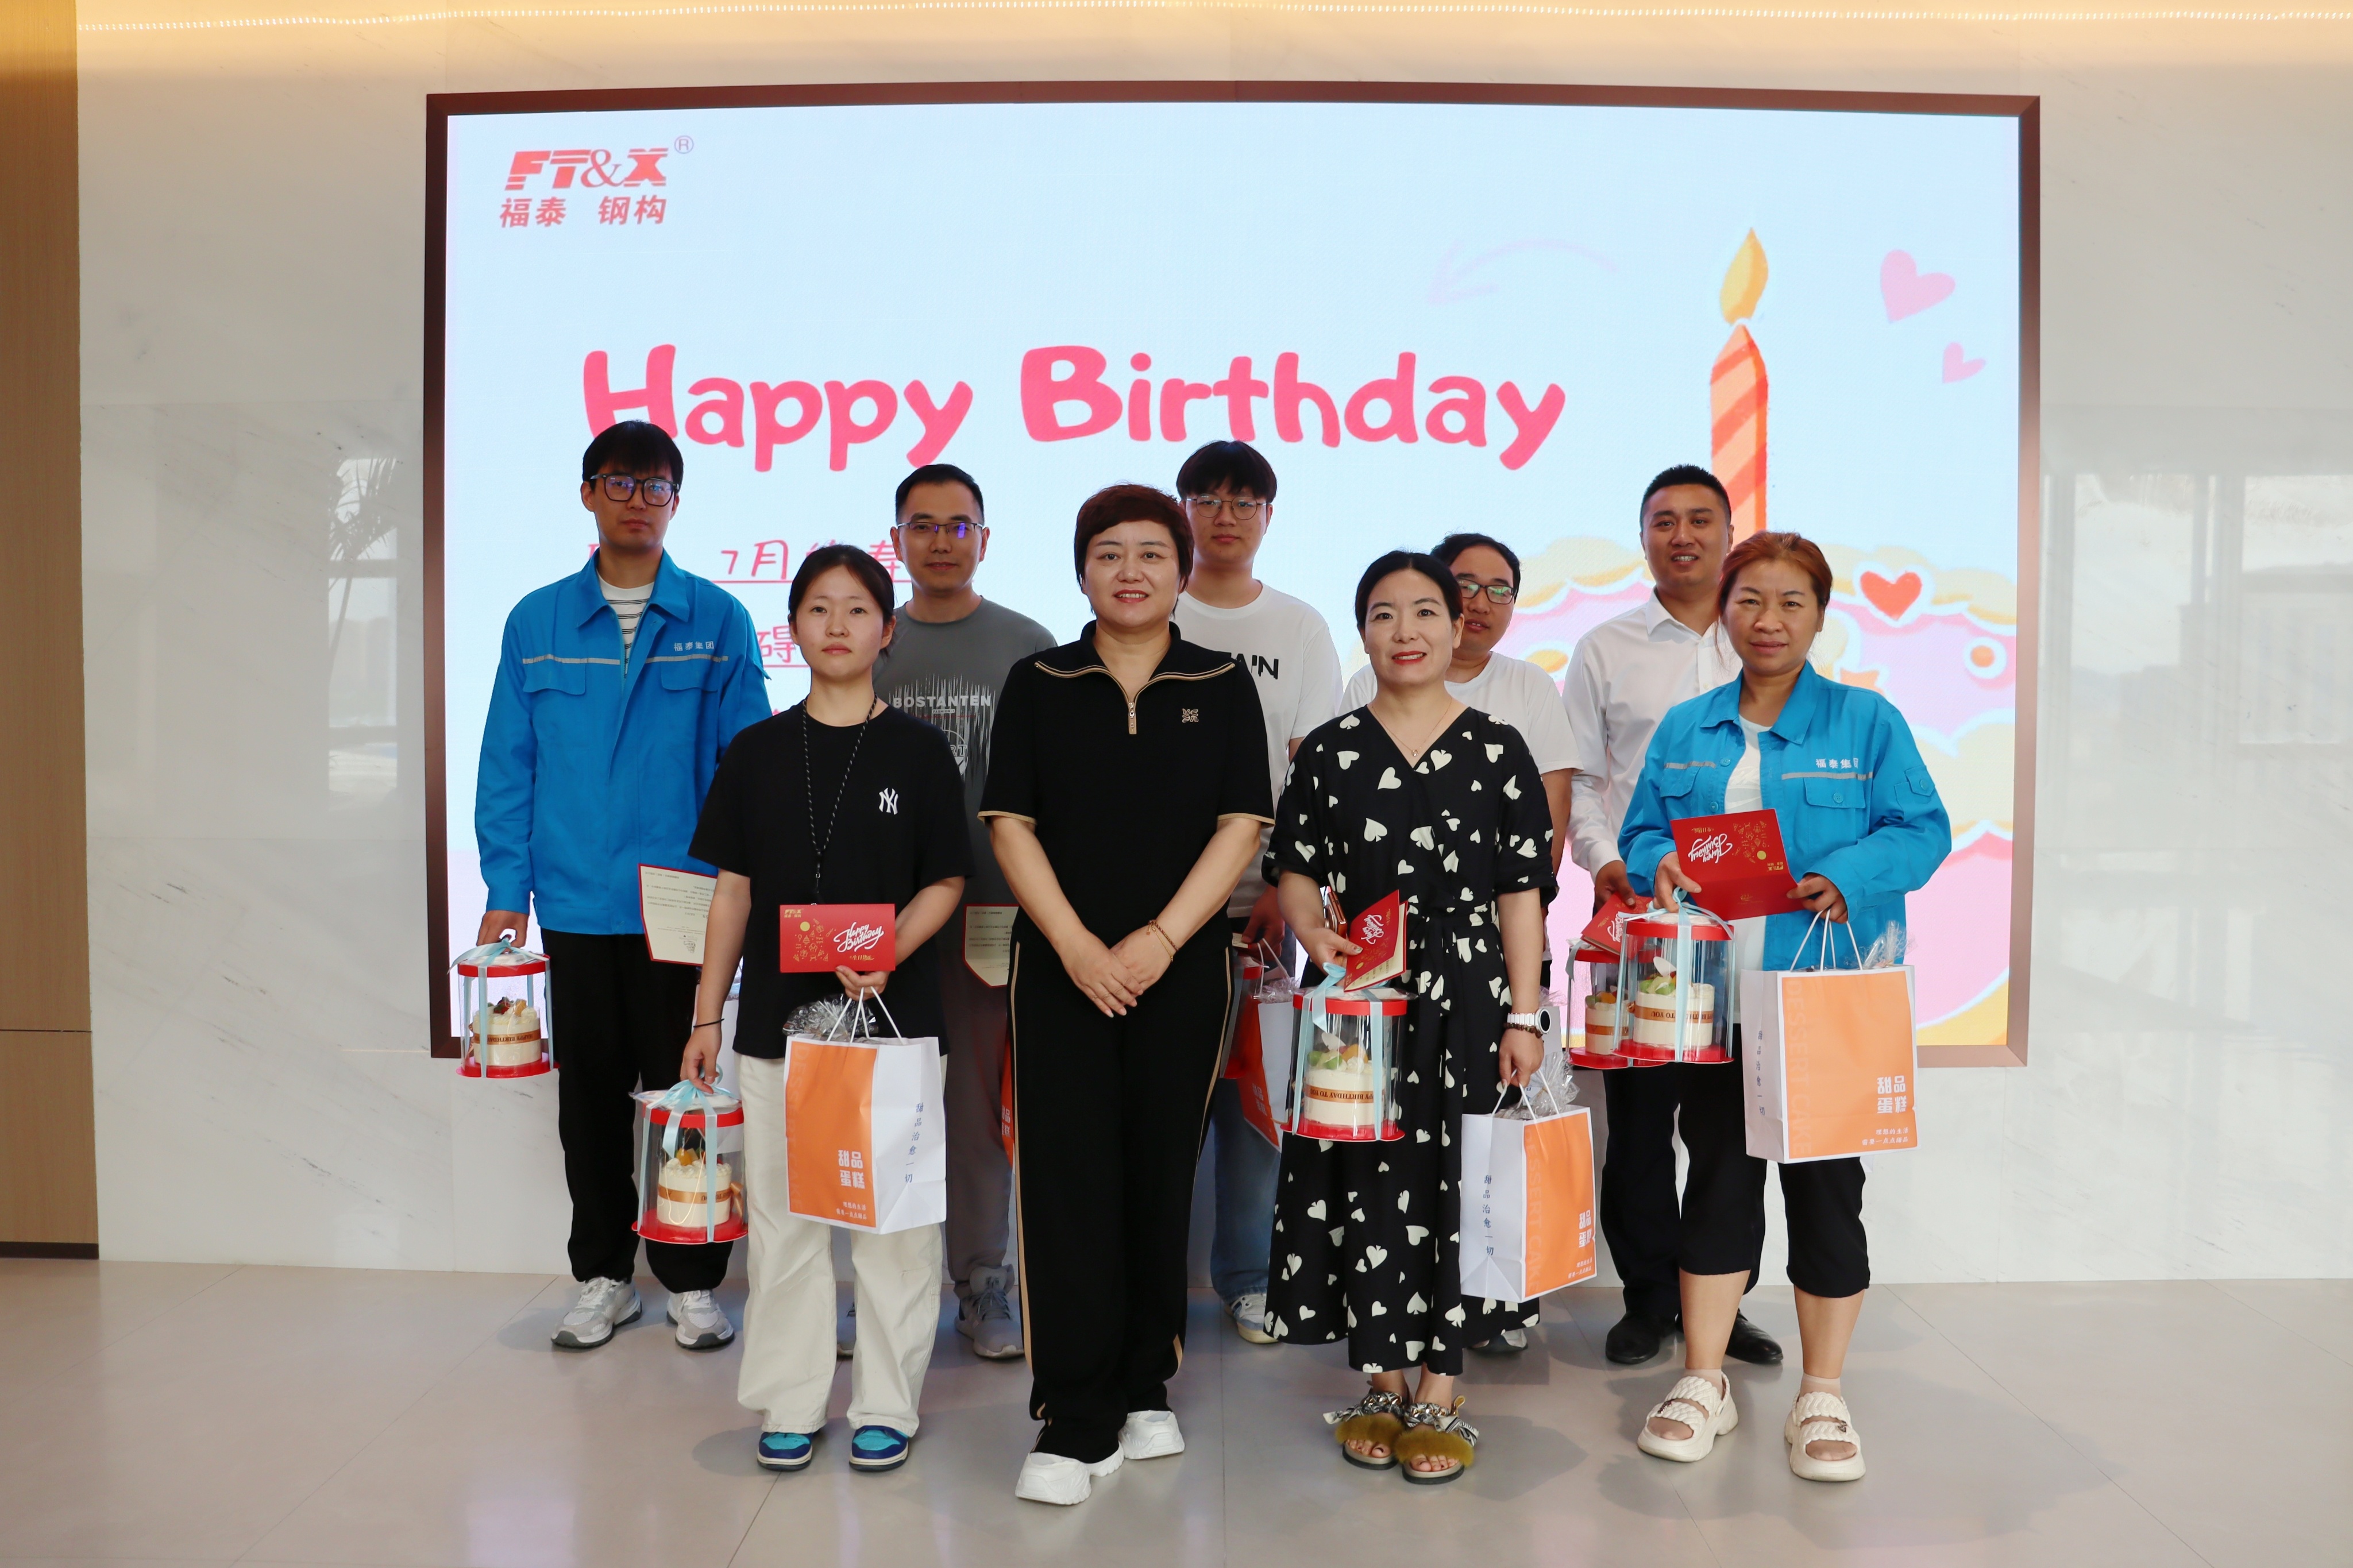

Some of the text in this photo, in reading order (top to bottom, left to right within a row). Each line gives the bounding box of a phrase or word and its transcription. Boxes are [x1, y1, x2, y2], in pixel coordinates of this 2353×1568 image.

[504, 148, 669, 191] FT&X
[500, 195, 667, 228] 福泰 钢构
[583, 343, 1565, 472] Happy Birthday
[673, 641, 715, 652] 福泰集团
[893, 695, 992, 708] BOSTANTEN
[1815, 758, 1859, 769] 福泰集团
[1688, 835, 1719, 862] Birthday
[847, 926, 884, 952] Birthday
[1877, 1075, 1906, 1094] 甜品
[1329, 1092, 1364, 1100] BIRTHDAY
[1877, 1095, 1907, 1114] 蛋糕
[1862, 1136, 1908, 1146] 需要一点点甜品
[1876, 1127, 1908, 1136] 理想的生活
[904, 1102, 924, 1184] 甜品治愈一切
[838, 1149, 863, 1169] 甜品
[840, 1169, 866, 1189] 蛋糕
[1482, 1175, 1494, 1256] 甜品治愈一切
[1579, 1209, 1591, 1229] 甜品
